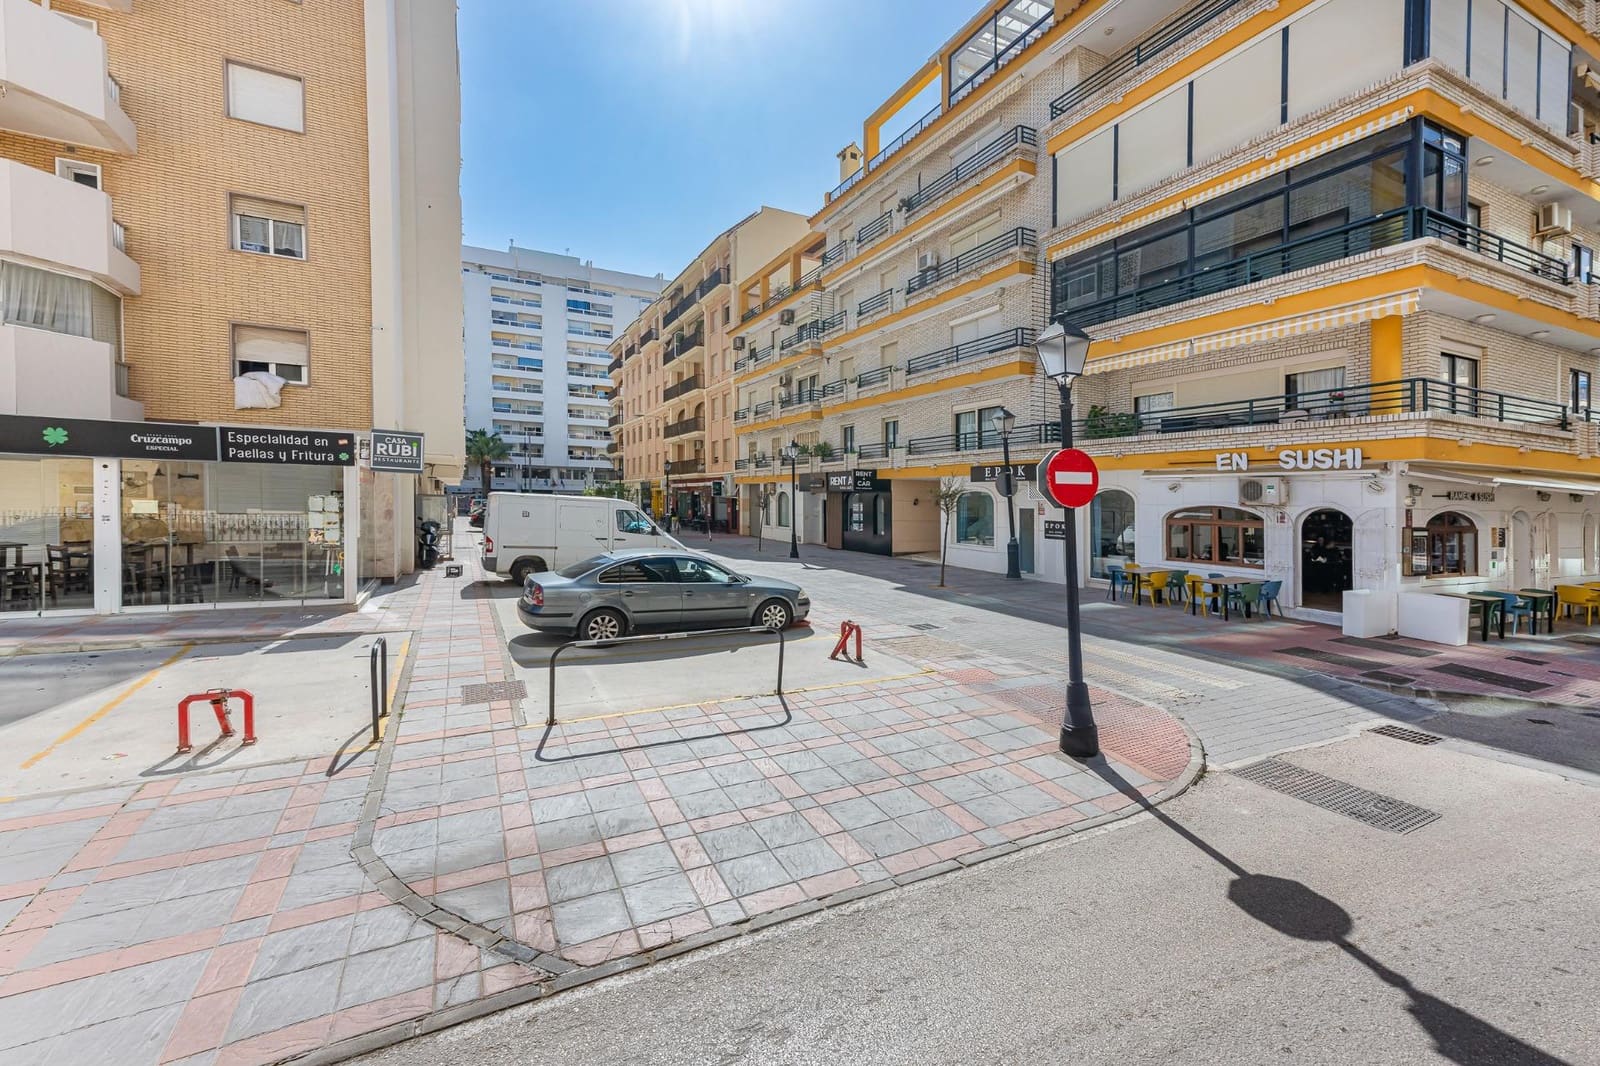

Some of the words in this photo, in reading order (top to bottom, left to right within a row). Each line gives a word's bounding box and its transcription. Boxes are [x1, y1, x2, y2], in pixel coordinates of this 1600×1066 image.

[130, 433, 192, 446] Cruzcampo
[227, 431, 309, 446] Especialidad
[314, 438, 329, 447] en
[384, 436, 407, 445] CASA
[229, 447, 275, 459] Paellas
[279, 451, 287, 462] y
[291, 450, 335, 461] Fritura
[1215, 452, 1248, 471] EN
[1278, 447, 1362, 470] SUSHI
[830, 476, 847, 486] RENT
